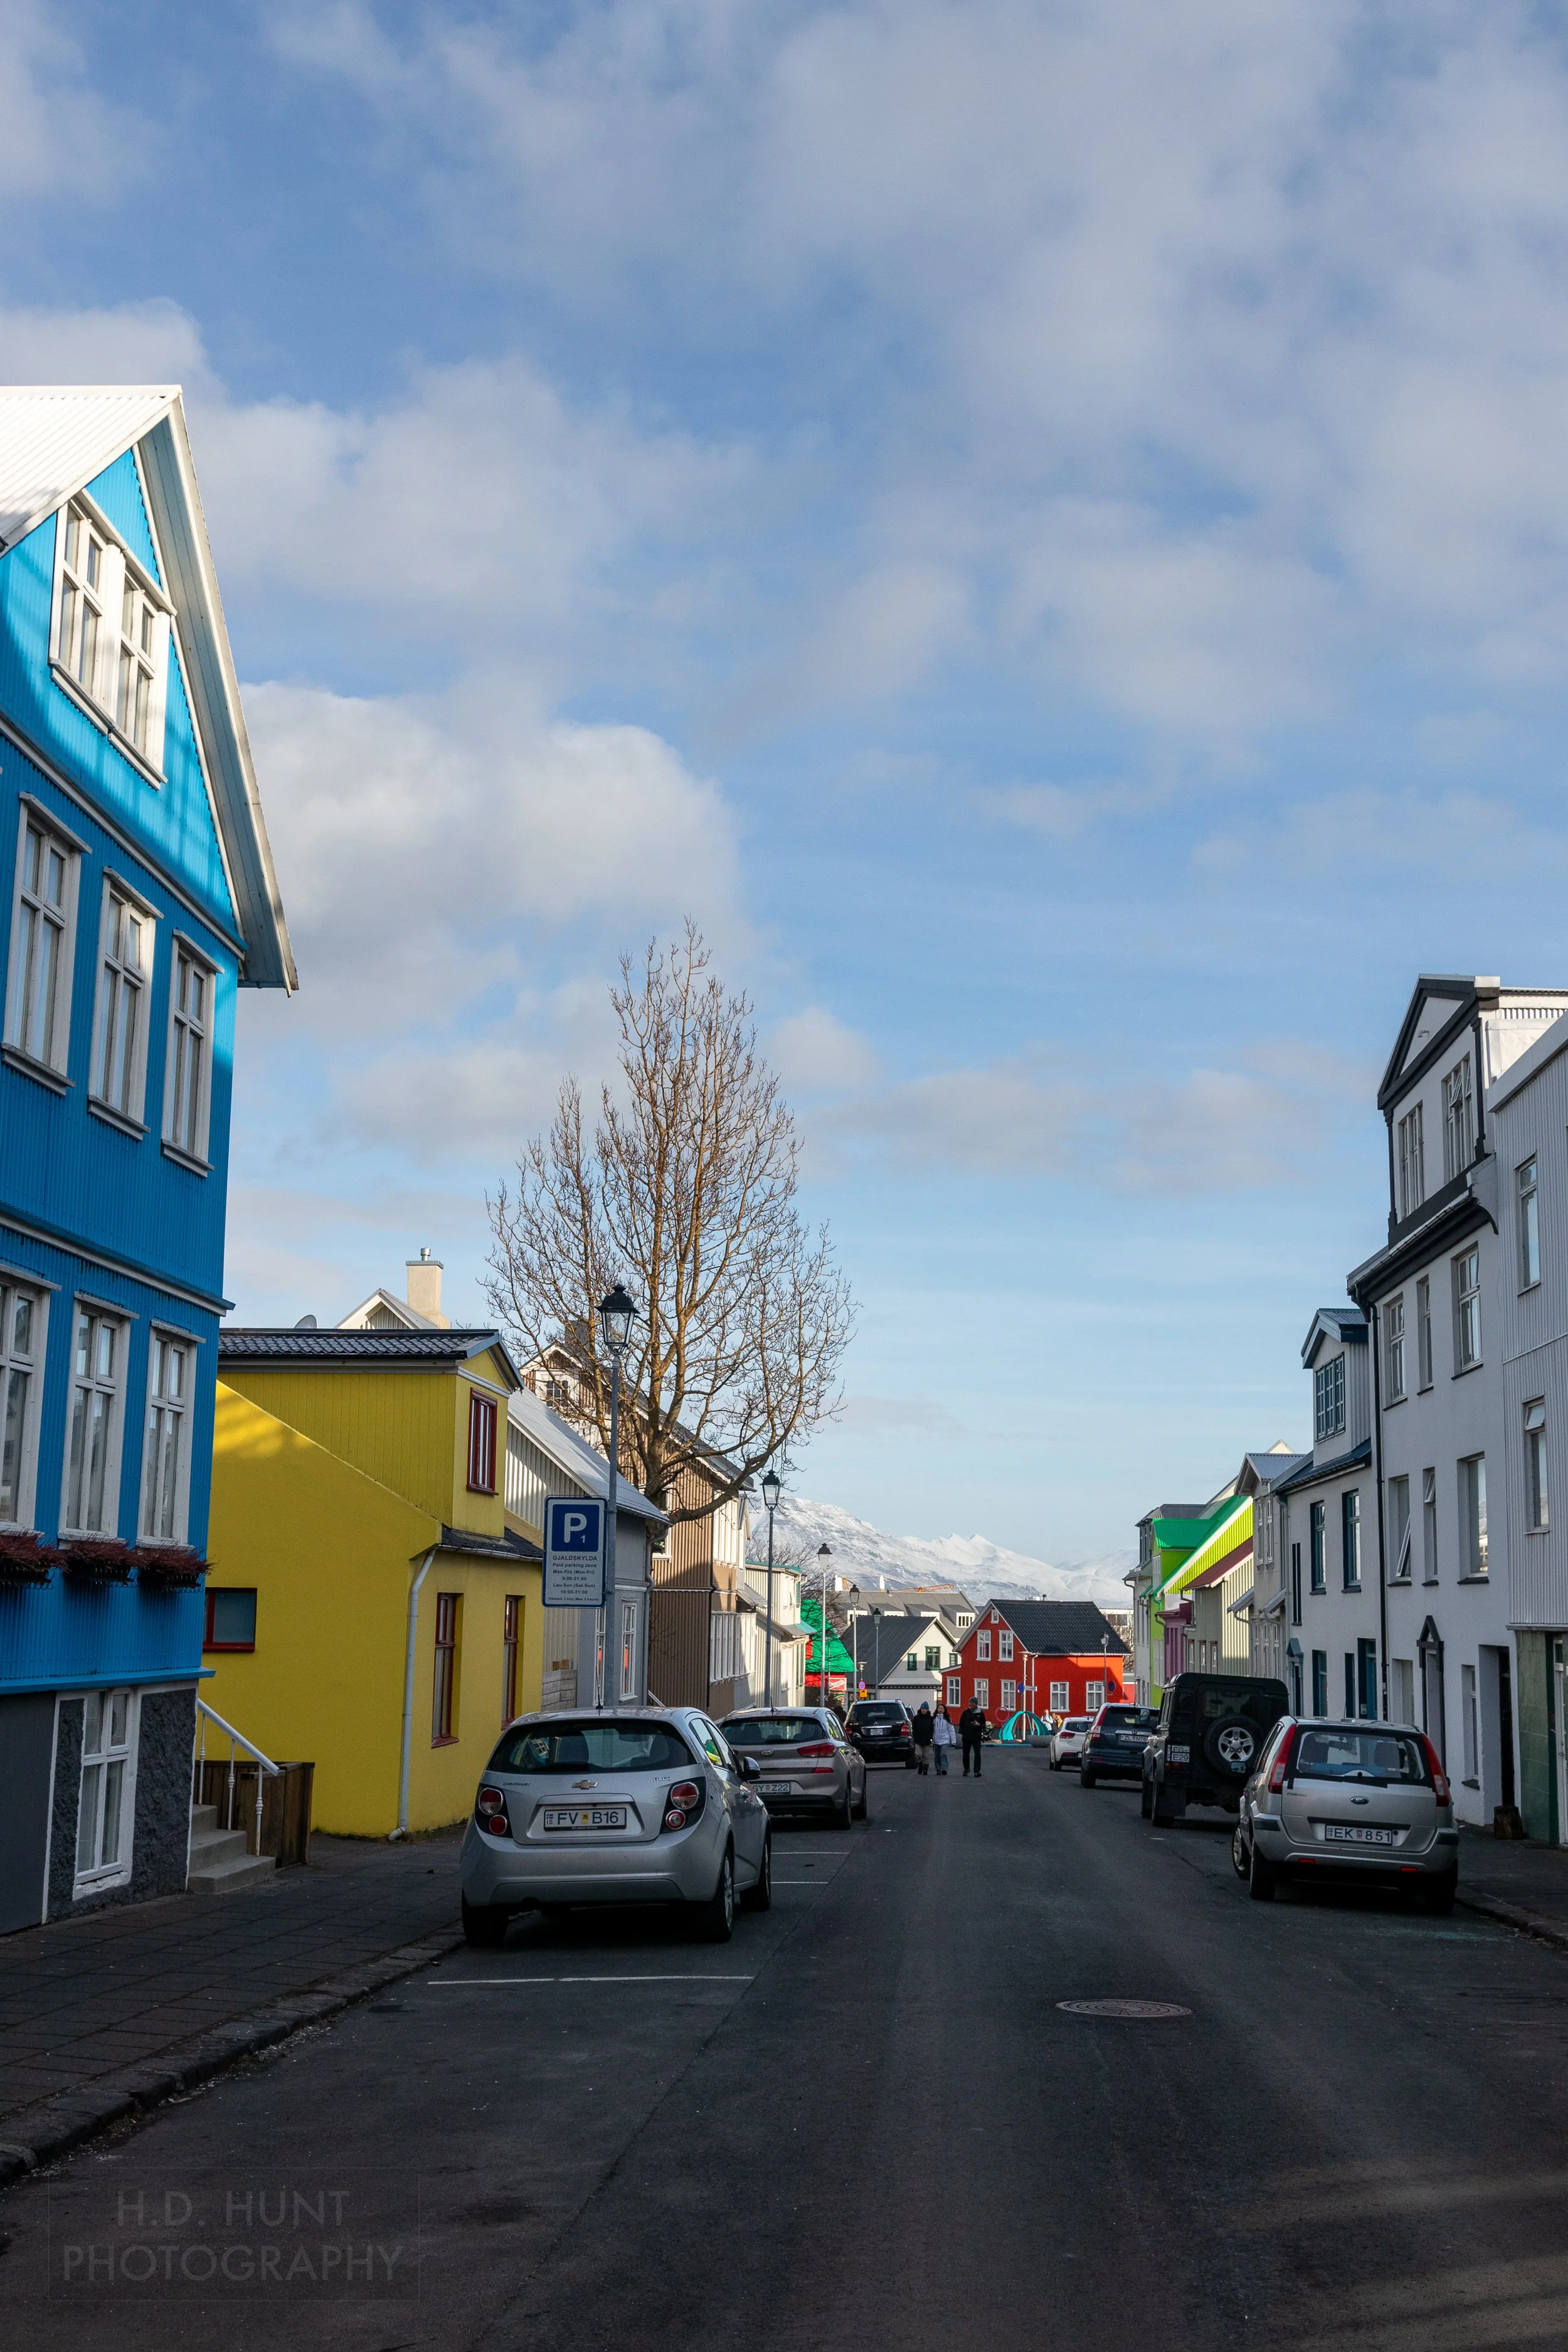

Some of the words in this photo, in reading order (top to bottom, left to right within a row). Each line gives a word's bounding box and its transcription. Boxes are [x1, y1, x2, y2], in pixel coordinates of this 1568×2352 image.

[564, 1513, 587, 1543] P
[581, 1535, 586, 1544] 1
[753, 1784, 765, 1793] GY
[771, 1784, 788, 1792] Z22
[557, 1812, 579, 1825] FV
[591, 1811, 619, 1825] B16
[1334, 1828, 1353, 1840] EK
[1365, 1830, 1390, 1842] 851
